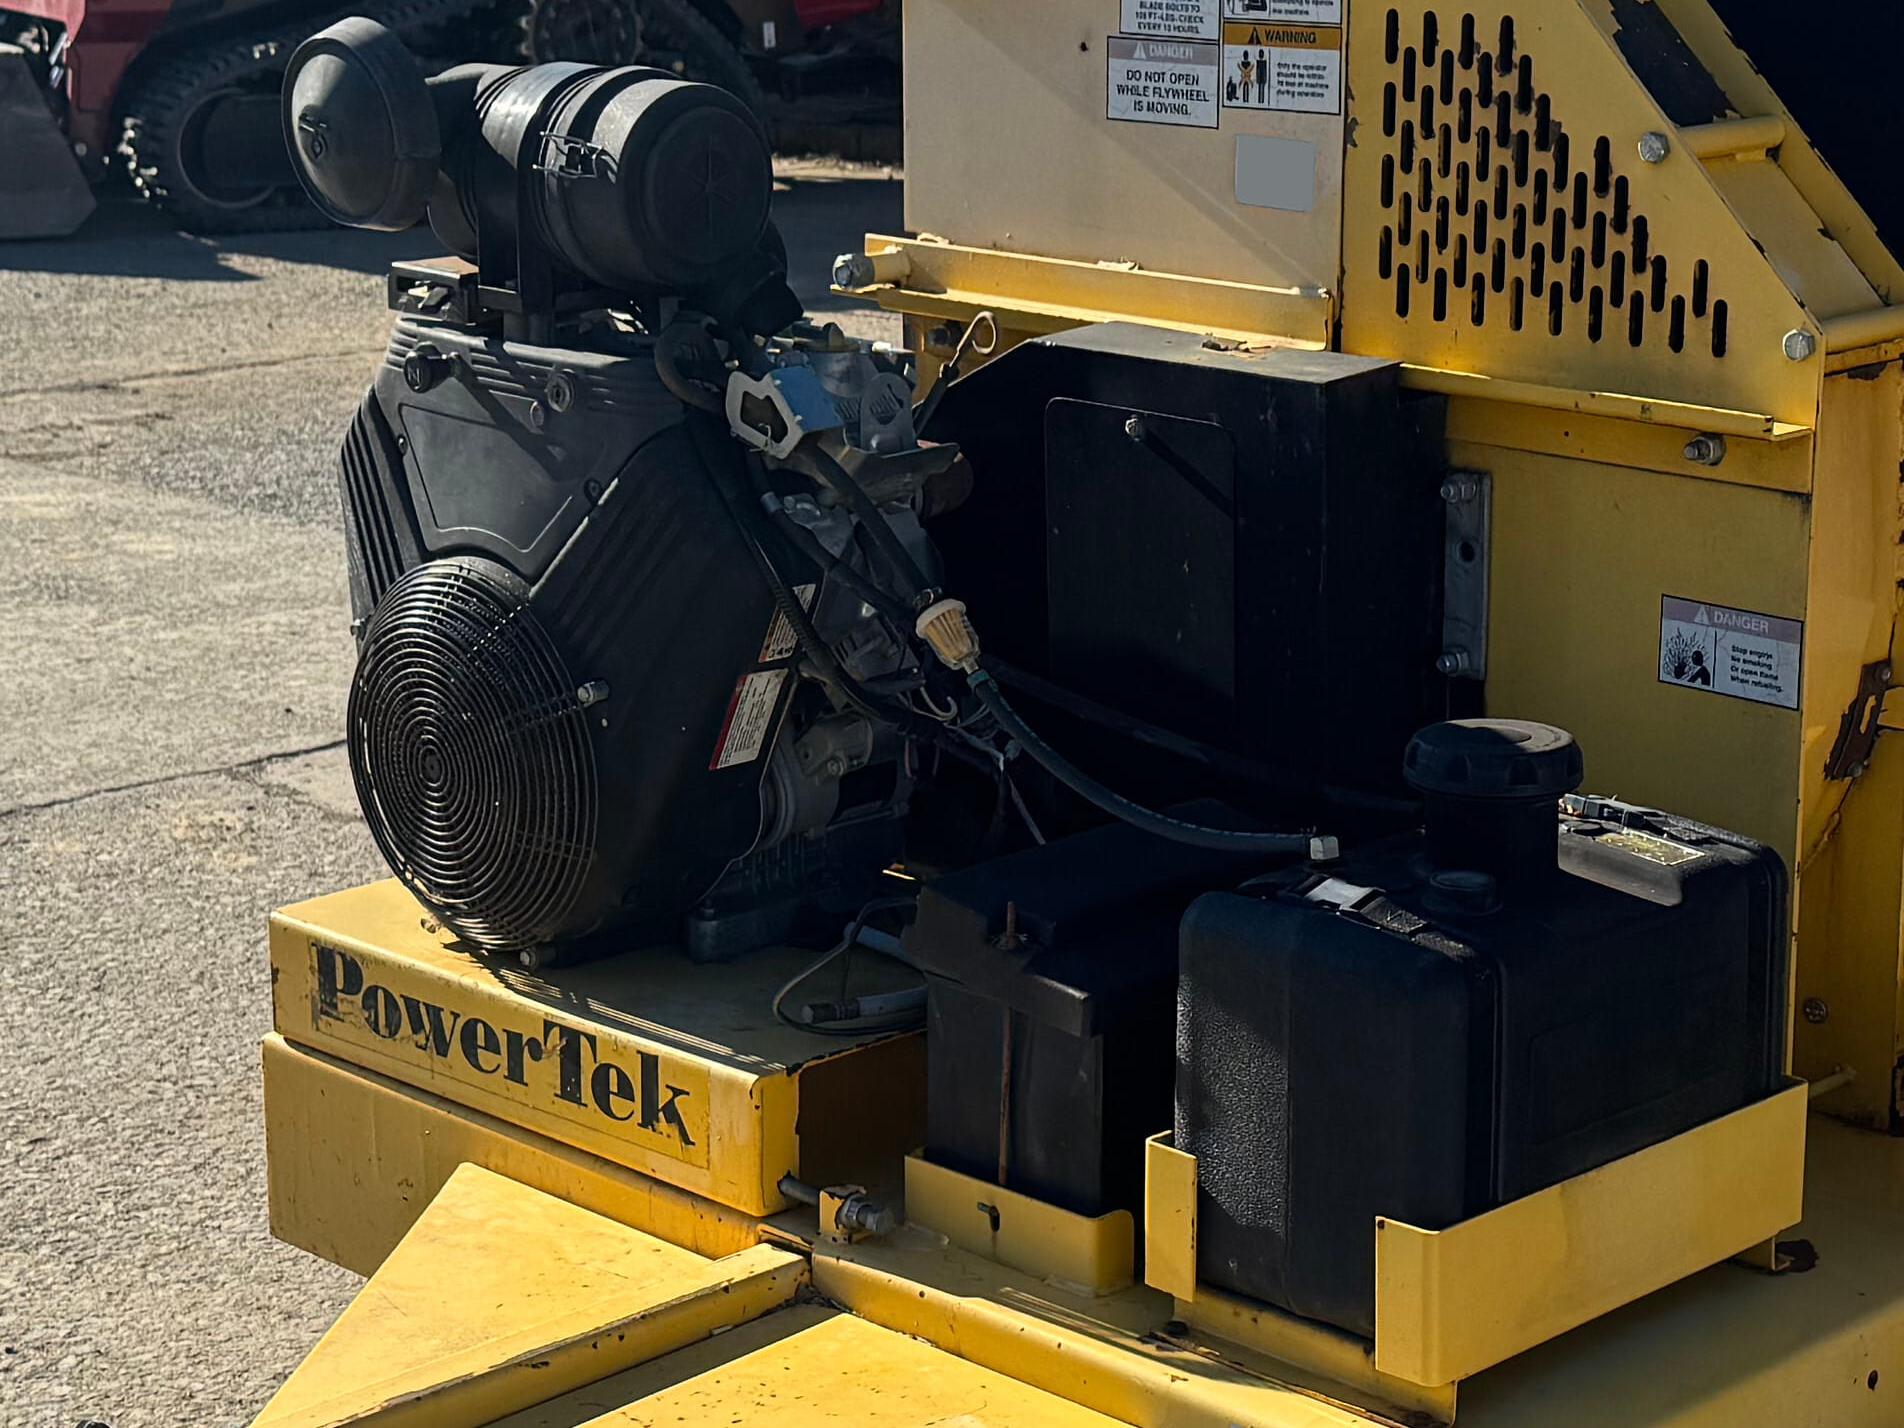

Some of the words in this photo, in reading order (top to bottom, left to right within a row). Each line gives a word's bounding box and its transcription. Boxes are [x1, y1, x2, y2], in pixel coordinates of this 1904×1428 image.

[1264, 29, 1316, 44] WARNING
[1126, 69, 1142, 81] DO
[1144, 71, 1166, 83] NOT
[1169, 72, 1200, 86] OPEN
[1116, 84, 1150, 97] WHILE
[1152, 86, 1210, 102] FLYWHEEL
[1133, 99, 1143, 112] IS
[1714, 610, 1769, 634] DANGER
[1732, 645, 1748, 655] Stop
[1741, 668, 1758, 676] open
[1742, 658, 1772, 671] smoking
[309, 941, 696, 1147] PowerTek
